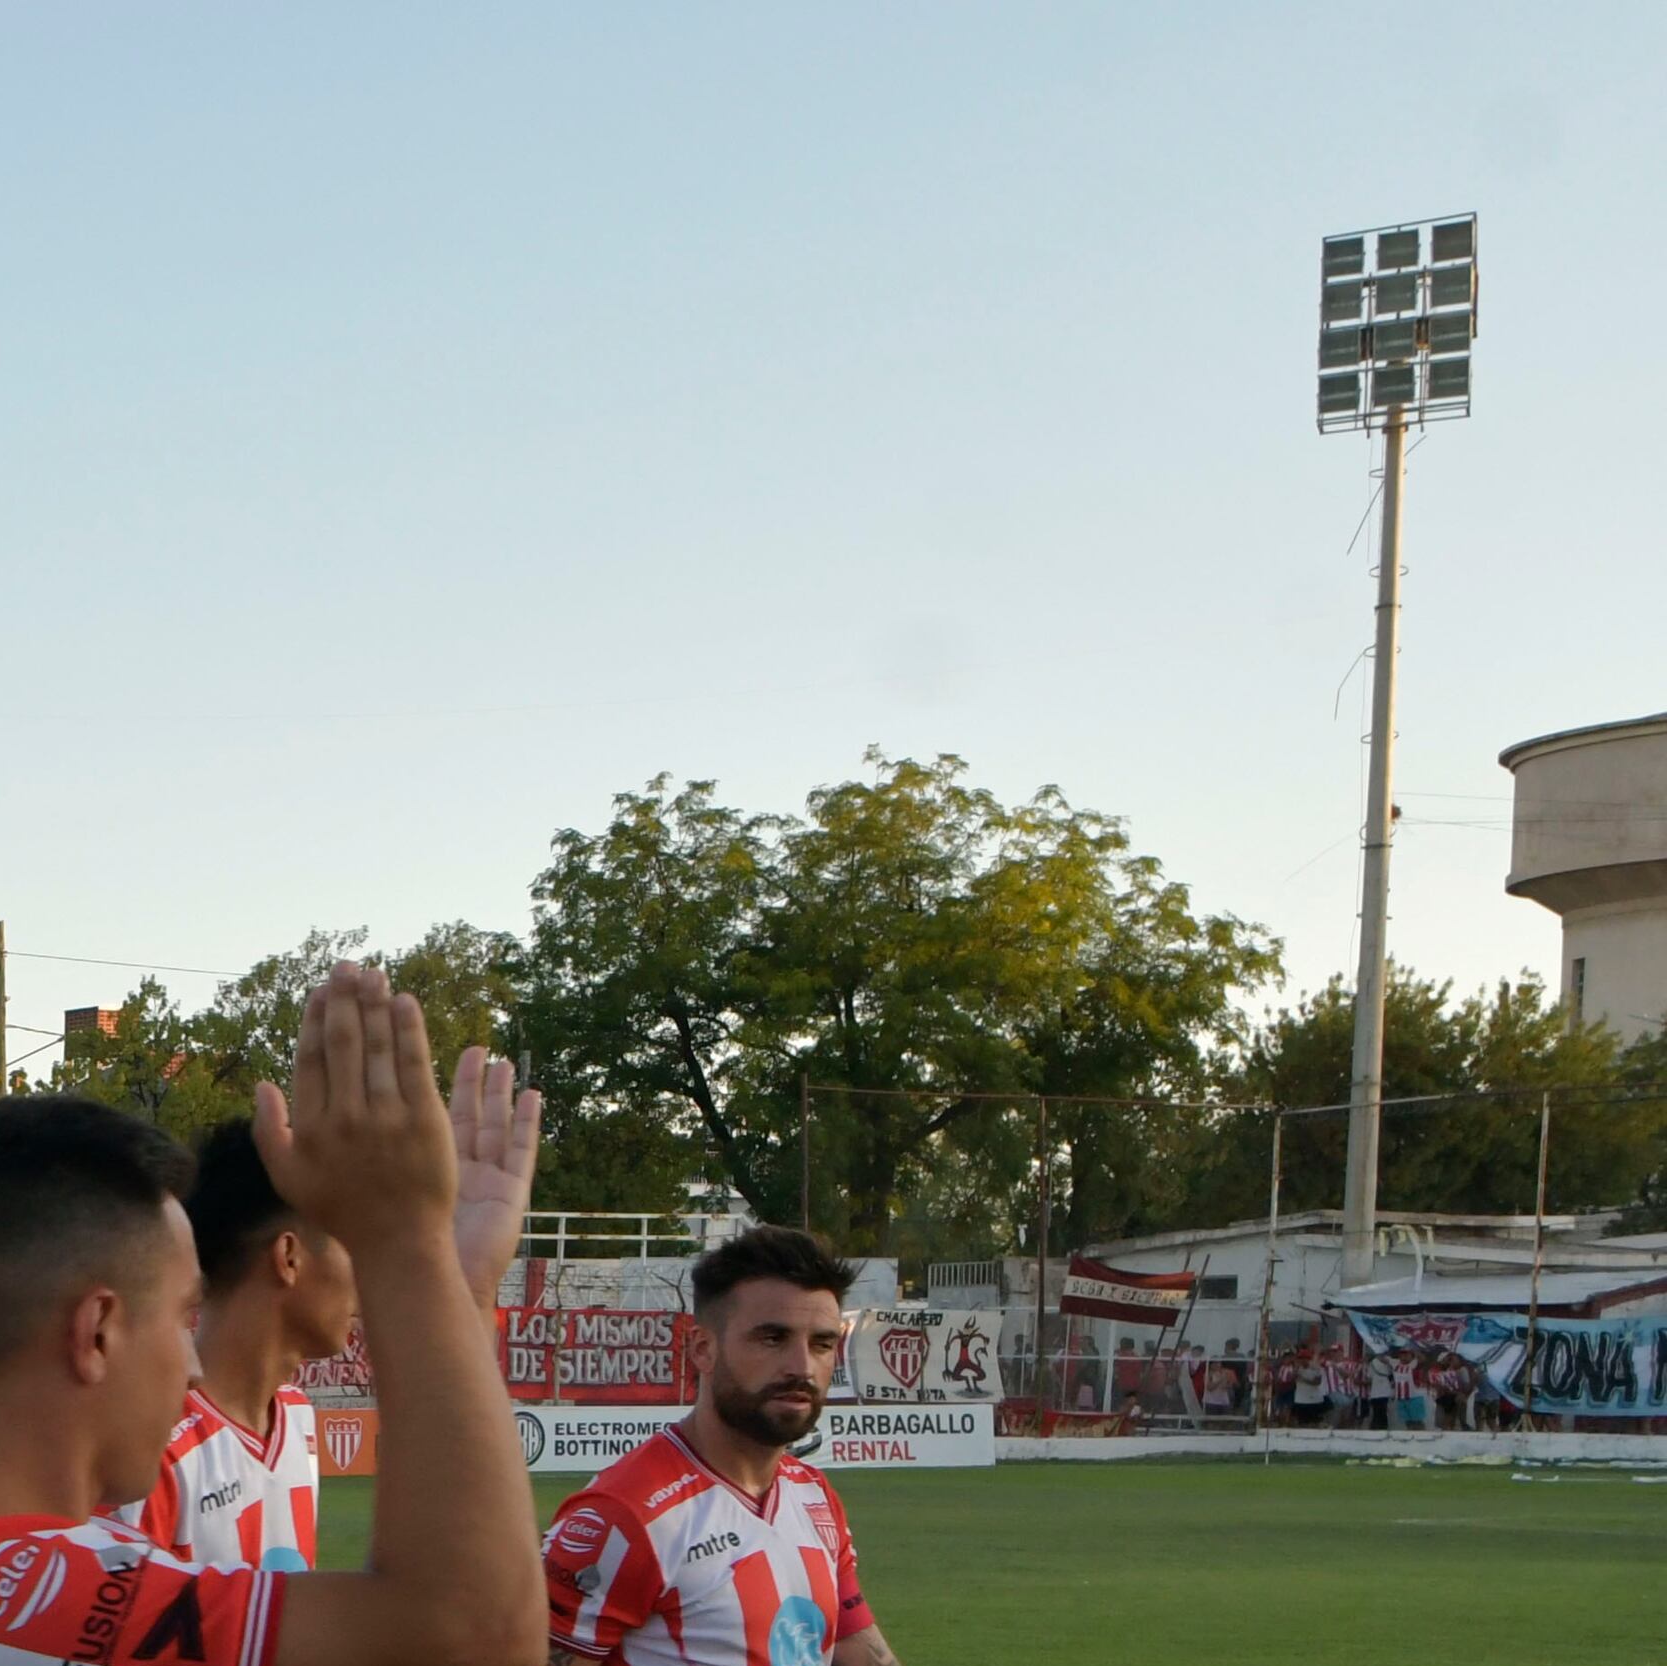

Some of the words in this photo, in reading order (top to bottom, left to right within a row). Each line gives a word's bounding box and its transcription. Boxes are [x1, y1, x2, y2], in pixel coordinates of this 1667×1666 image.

[508, 1311, 566, 1345] LOS
[574, 1314, 673, 1347] MISMOS
[508, 1348, 546, 1383] DE
[556, 1348, 673, 1384] SIEMPRE
[831, 1413, 975, 1435] BARBAGALLO
[832, 1440, 917, 1462] RENTAL
[687, 1531, 741, 1563] mitre
